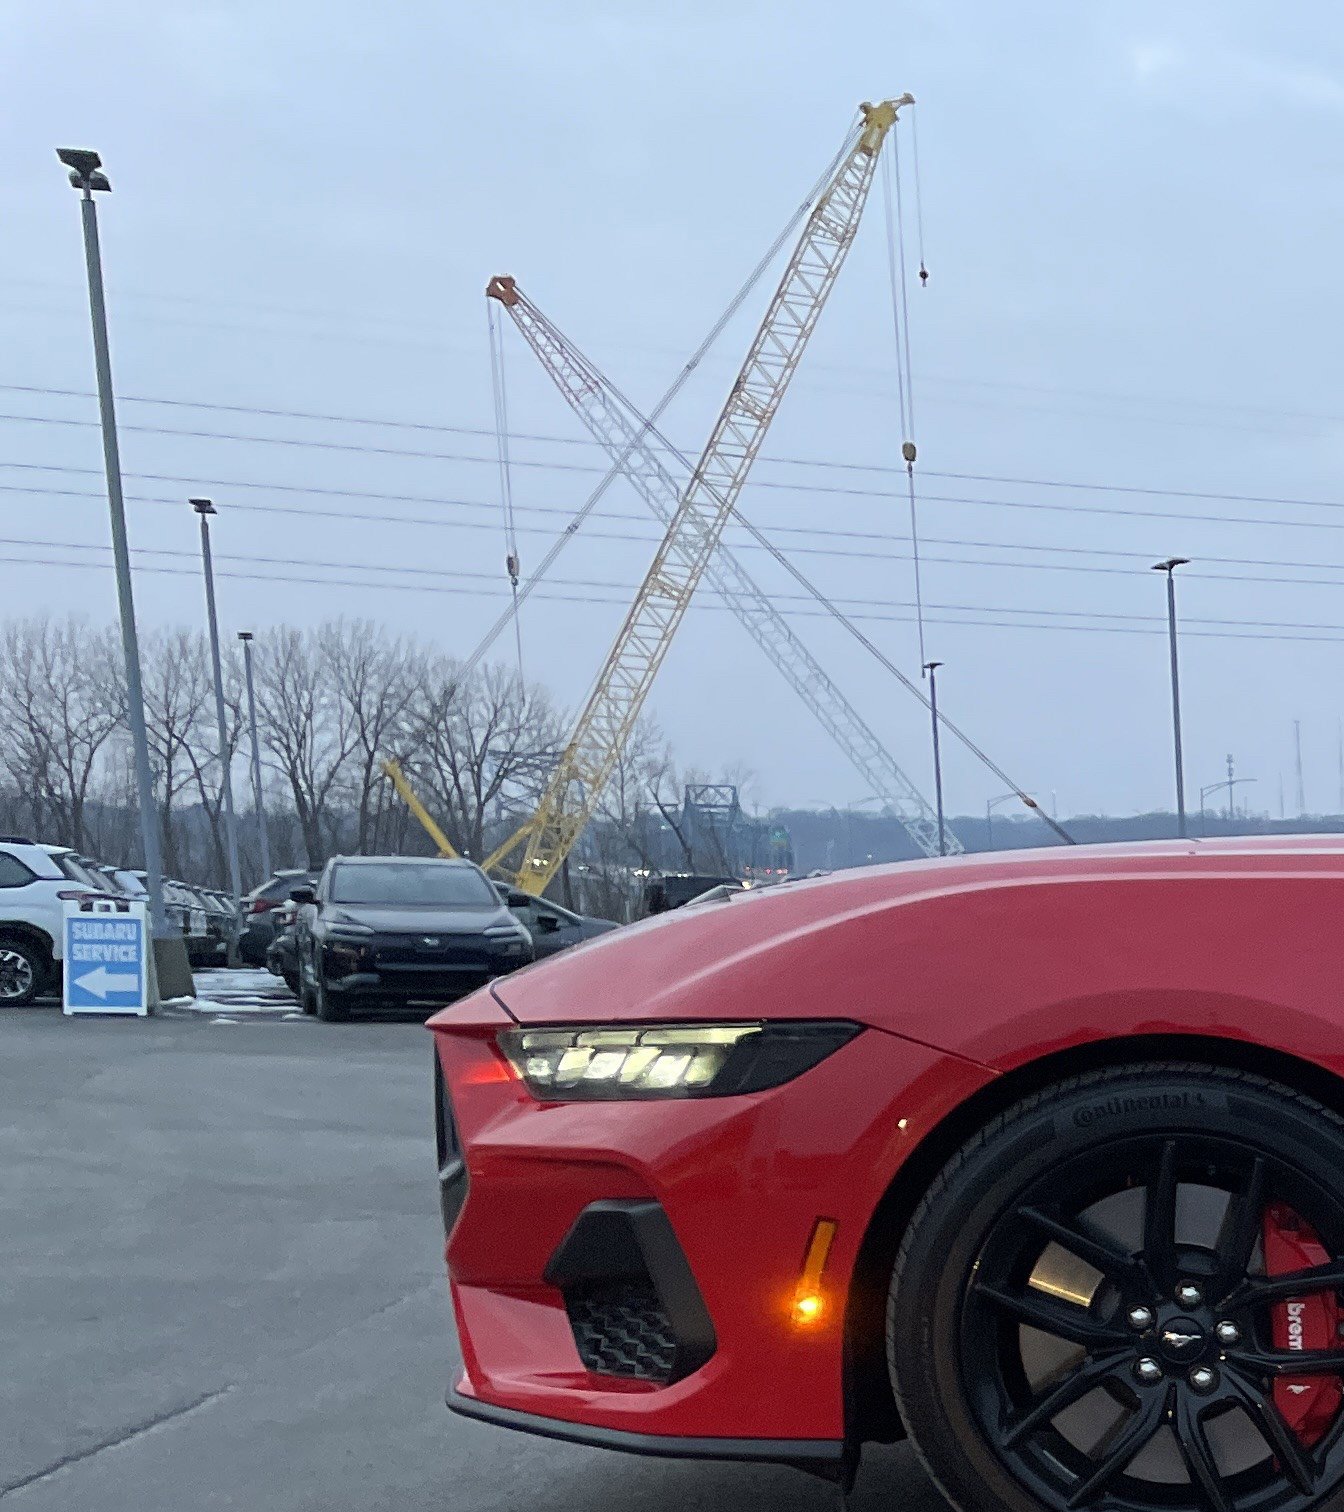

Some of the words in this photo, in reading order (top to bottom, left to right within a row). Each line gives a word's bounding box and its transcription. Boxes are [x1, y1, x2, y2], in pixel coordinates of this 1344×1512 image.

[72, 922, 137, 940] SUBARU
[73, 943, 137, 961] SERVICE
[1287, 1303, 1305, 1350] brem
